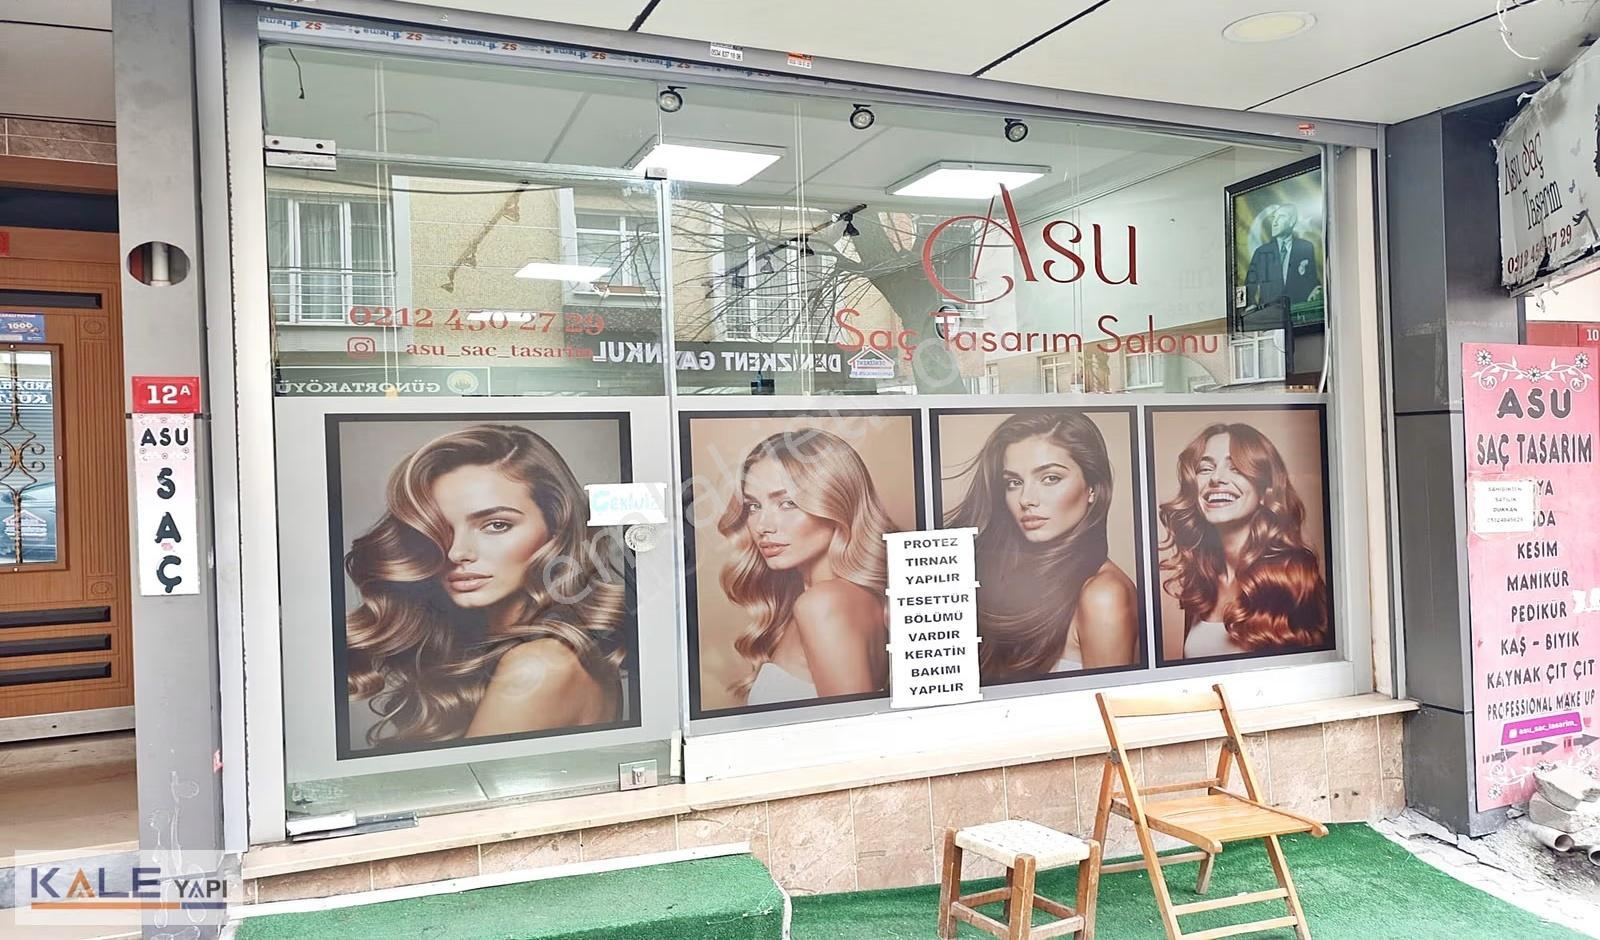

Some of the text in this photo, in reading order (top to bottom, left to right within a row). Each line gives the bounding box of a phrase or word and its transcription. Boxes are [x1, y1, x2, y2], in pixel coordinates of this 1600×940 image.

[922, 182, 1138, 304] Asu
[1560, 224, 1572, 248] 29
[350, 307, 433, 328] 0212
[444, 308, 508, 331] 450
[520, 311, 556, 333] 27
[836, 308, 1218, 361] Saç Tasarım Salonu
[1586, 328, 1599, 342] 10
[1497, 388, 1571, 419] ASU
[140, 428, 189, 446] ASU
[1477, 433, 1592, 471] SAÇ TASARIM
[904, 538, 958, 549] PROTEZ
[905, 556, 958, 567] TIRNAK
[905, 573, 960, 585] YAPILIR
[897, 594, 969, 606] TESETTÜR
[904, 612, 963, 624] BÖLÜMÜ
[909, 630, 960, 642] VARDIR
[1501, 636, 1526, 657] KAŞ
[1545, 631, 1579, 650] BIYIK
[905, 646, 966, 660] KERATİN
[911, 665, 961, 678] BAKIMI
[1487, 659, 1595, 689] KAYNAK ÇIT ÇIT
[909, 683, 964, 696] YAPILIR
[1487, 688, 1595, 720] PROFESSIONAL MAKE UP
